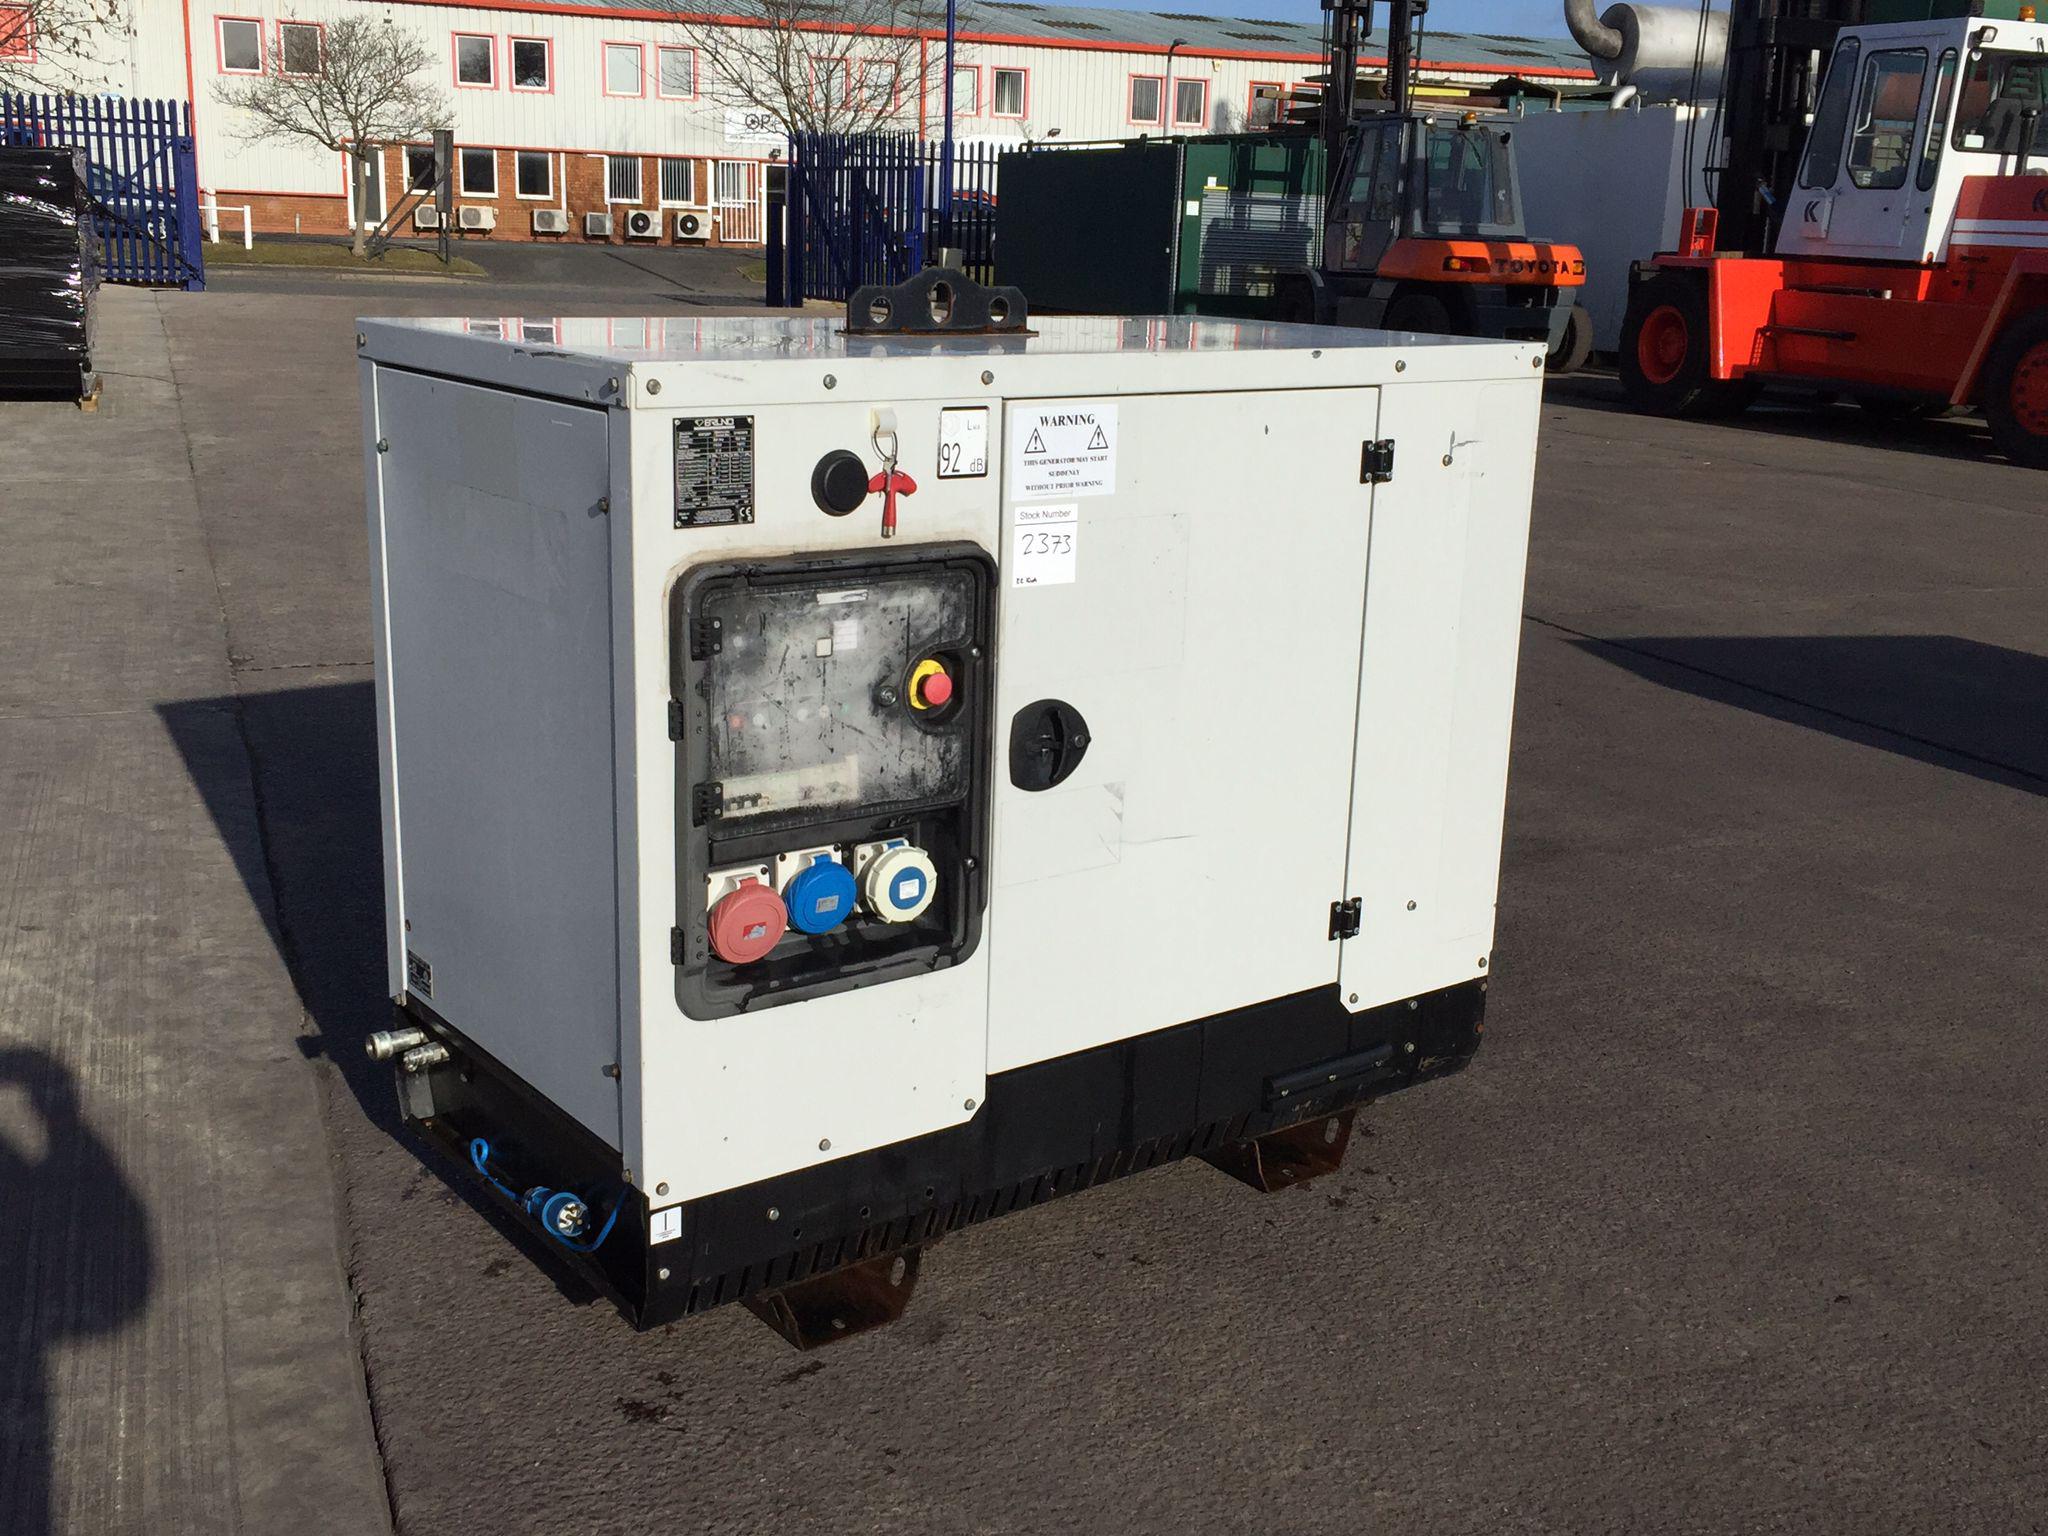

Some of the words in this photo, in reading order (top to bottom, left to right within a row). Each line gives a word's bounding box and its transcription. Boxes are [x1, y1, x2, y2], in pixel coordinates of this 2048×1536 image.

[1495, 257, 1570, 275] TOYOTA
[704, 418, 735, 427] BRUNO
[1040, 413, 1095, 427] WARNING
[941, 442, 961, 473] 92
[969, 457, 984, 473] dB
[1039, 456, 1075, 466] GENERATOR
[1076, 455, 1088, 463] MAY
[1025, 483, 1054, 491] WITHOUT
[1055, 481, 1074, 490] PRIOR
[1075, 480, 1103, 488] WARNING
[1020, 511, 1040, 520] Stock
[1042, 510, 1071, 519] Number
[1022, 533, 1071, 556] 2373
